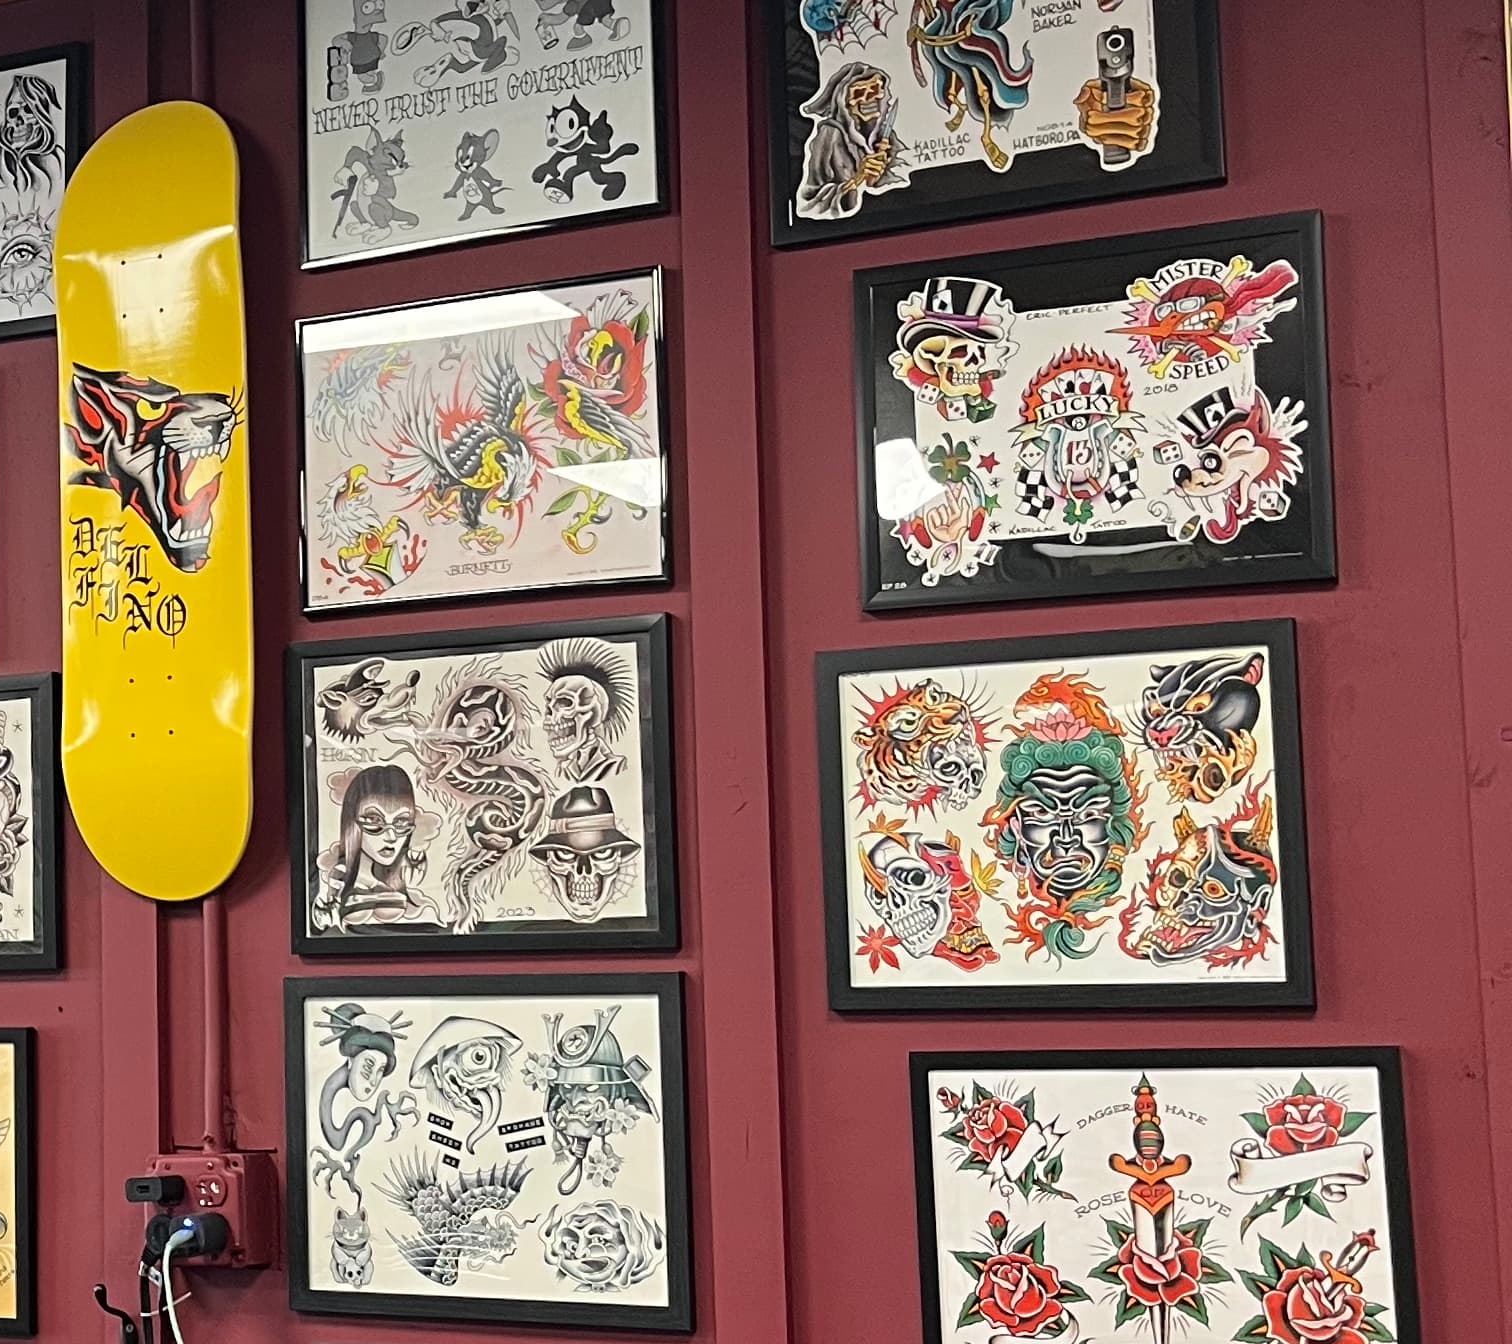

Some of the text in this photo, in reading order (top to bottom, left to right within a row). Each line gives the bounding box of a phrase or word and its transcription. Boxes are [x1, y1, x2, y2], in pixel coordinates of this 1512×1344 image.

[1032, 13, 1077, 33] BAKER
[313, 46, 644, 135] NEVER TRUST THE GOVERNMENT
[913, 132, 971, 153] KADILLAC
[913, 145, 965, 164] TATTOO
[1151, 262, 1224, 292] MISTER
[1058, 304, 1112, 318] PERFECT
[1169, 355, 1230, 380] SPEED
[1038, 396, 1116, 420] LUCKY
[1065, 440, 1092, 466] 13
[496, 906, 536, 919] 2023
[1076, 1103, 1134, 1130] DAGGER
[1165, 1104, 1208, 1126] HATE
[1074, 1190, 1127, 1218] ROSE
[1177, 1189, 1232, 1218] LOVE
